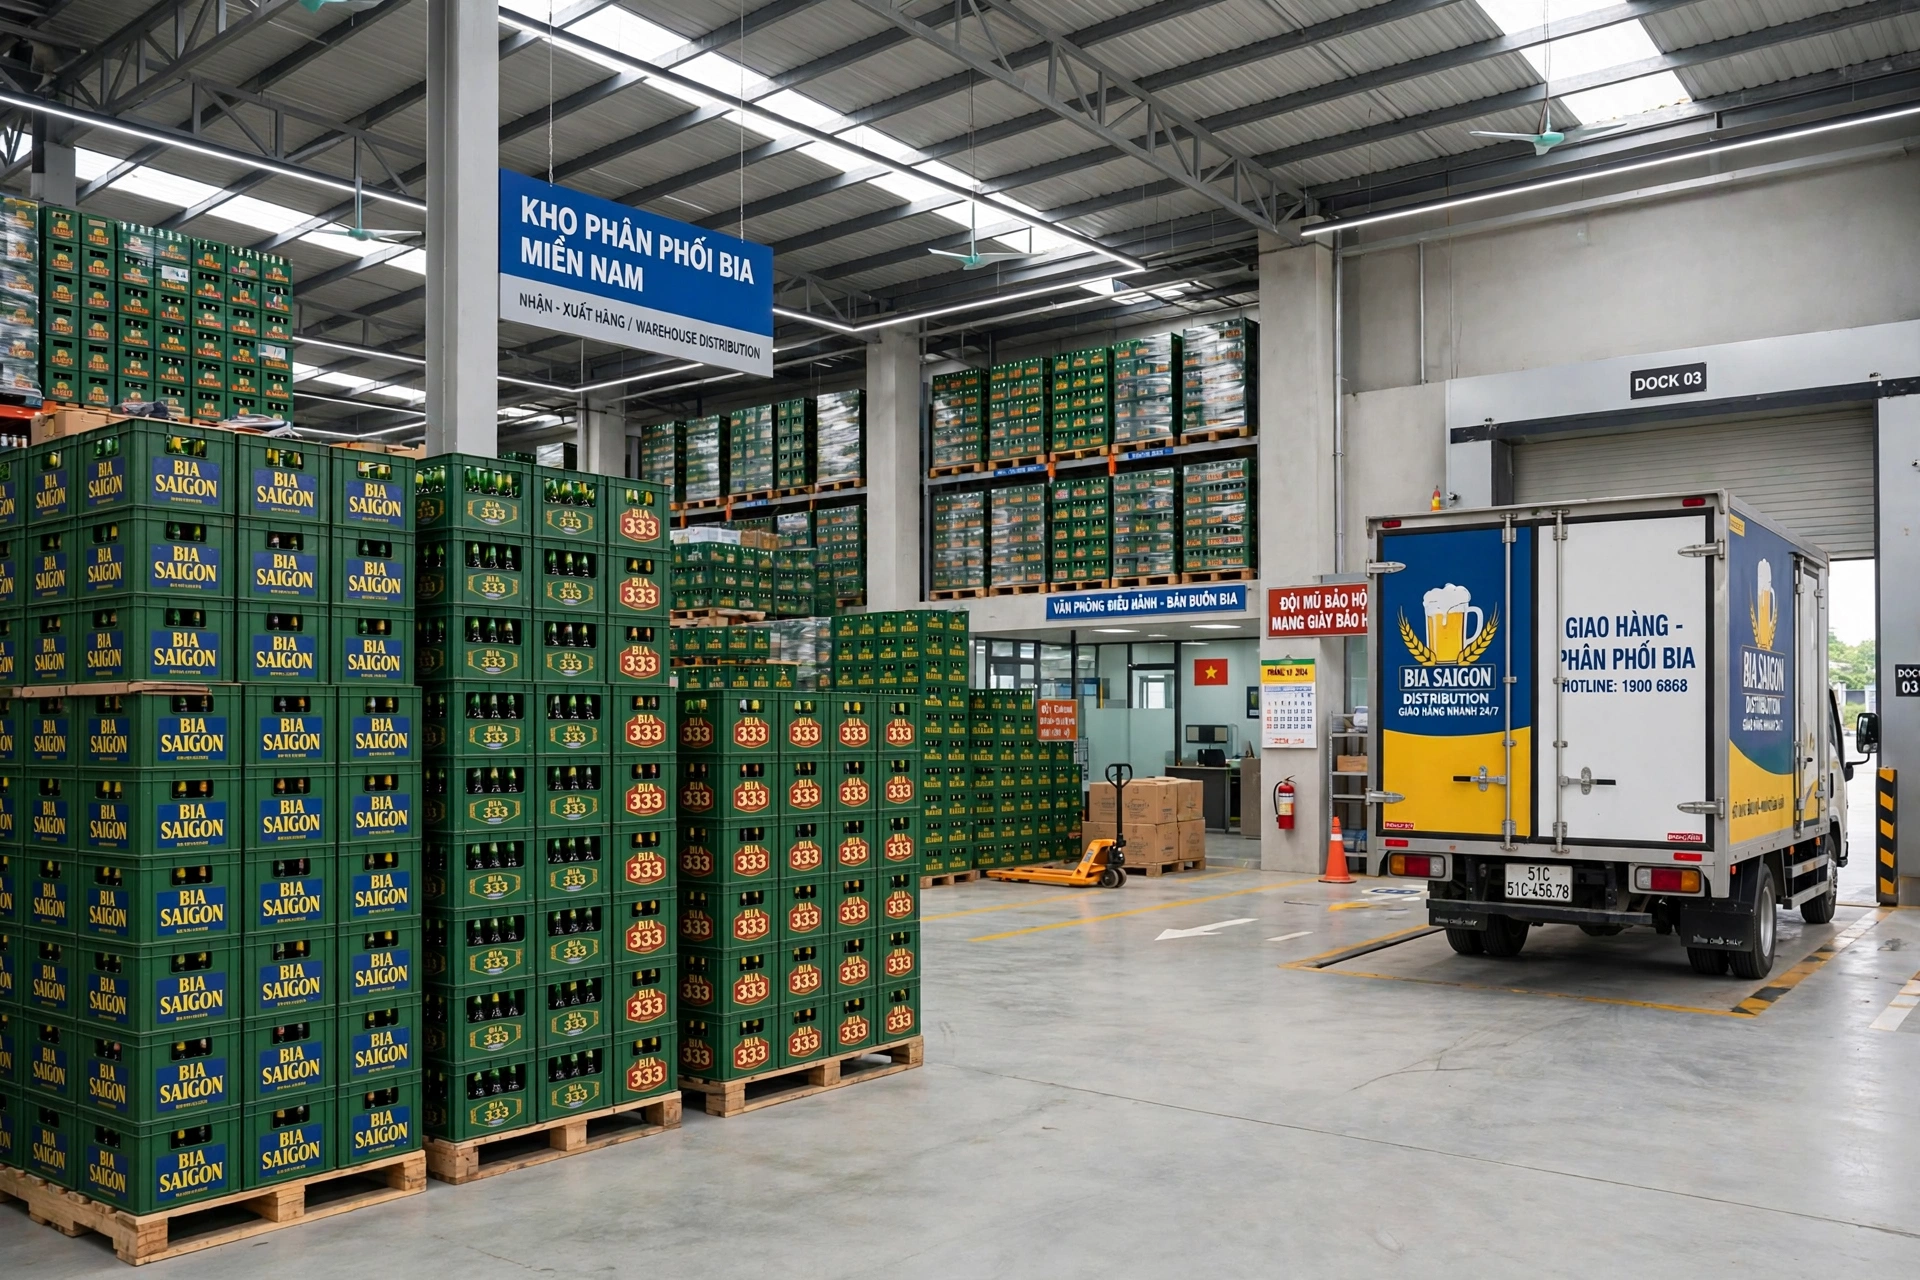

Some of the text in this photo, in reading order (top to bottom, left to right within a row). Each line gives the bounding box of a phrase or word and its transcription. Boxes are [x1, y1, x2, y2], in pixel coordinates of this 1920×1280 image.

[521, 195, 755, 285] KHO PHÂN PHỐI BIA
[521, 235, 643, 292] MIỀN NAM
[519, 293, 553, 315] NHẬN
[563, 301, 593, 321] XUẤT
[627, 316, 633, 331] /
[636, 320, 697, 345] WAREHOUSE
[700, 334, 761, 360] DISTRIBUTION
[1635, 371, 1702, 391] DOCK 03
[98, 458, 113, 477] BIA
[174, 460, 200, 477] BIA
[88, 475, 123, 498] SAIGON
[155, 474, 217, 497] SAIGON
[274, 472, 297, 488] BIA
[256, 485, 314, 507] SAIGON
[365, 483, 386, 498] BIA
[349, 496, 401, 516] SAIGON
[632, 508, 649, 519] BIA
[624, 518, 656, 535] 333
[174, 546, 199, 562] BIA
[274, 554, 297, 569] BIA
[154, 561, 216, 581] SAIGON
[365, 562, 386, 576] BIA
[256, 568, 313, 588] SAIGON
[348, 575, 401, 593] SAIGON
[632, 578, 649, 588] BIA
[624, 588, 656, 604] 333
[1220, 592, 1238, 605] BIA
[1272, 615, 1304, 631] MANG
[1565, 616, 1609, 639] GIAO
[1616, 610, 1669, 637] HÀNG
[173, 632, 198, 648] BIA
[274, 636, 296, 651] BIA
[364, 640, 385, 654] BIA
[154, 647, 216, 667] SAIGON
[632, 646, 649, 655] BIA
[1612, 640, 1656, 670] PHỐI
[1663, 646, 1696, 669] BIA
[256, 651, 313, 669] SAIGON
[347, 654, 400, 671] SAIGON
[624, 655, 656, 672] 333
[1404, 667, 1491, 687] BIA SAIGON
[1743, 651, 1784, 691] BIA SAIGON
[1897, 668, 1920, 678] DOC
[1562, 679, 1688, 693] HOTLINE: 1900 6868
[1902, 680, 1919, 694] 03
[1403, 692, 1489, 705] DISTRIBUTION
[1447, 706, 1477, 716] NHANH
[1479, 706, 1499, 716] 24/7
[100, 719, 117, 734] BIA
[180, 718, 206, 733] BIA
[281, 718, 304, 732] BIA
[372, 718, 392, 731] BIA
[638, 715, 654, 724] BIA
[745, 717, 760, 726] BIA
[848, 718, 860, 726] BIA
[894, 719, 906, 727] BIA
[483, 731, 508, 743] 333
[630, 724, 662, 741] 333
[737, 727, 766, 741] 333
[842, 728, 866, 741] 333
[889, 728, 911, 740] 333
[90, 735, 128, 754] SAIGON
[161, 734, 224, 753] SAIGON
[263, 733, 320, 751] SAIGON
[355, 733, 408, 749] SAIGON
[638, 784, 654, 793] BIA
[745, 782, 760, 790] BIA
[372, 796, 392, 810] BIA
[630, 793, 662, 809] 333
[737, 791, 766, 805] 333
[180, 804, 205, 819] BIA
[281, 800, 304, 814] BIA
[263, 814, 320, 833] SAIGON
[355, 810, 408, 828] SAIGON
[160, 819, 223, 840] SAIGON
[638, 852, 654, 862] BIA
[745, 845, 760, 854] BIA
[630, 862, 662, 878] 333
[737, 855, 766, 870] 333
[372, 874, 392, 889] BIA
[1527, 866, 1550, 881] 51C
[180, 889, 206, 906] BIA
[281, 882, 304, 897] BIA
[355, 888, 408, 907] SAIGON
[1507, 881, 1569, 899] 51C-456.78
[262, 895, 320, 917] SAIGON
[745, 909, 760, 918] BIA
[160, 904, 223, 927] SAIGON
[638, 920, 655, 930] BIA
[737, 918, 766, 935] 333
[630, 930, 662, 948] 333
[371, 952, 392, 967] BIA
[280, 964, 304, 980] BIA
[355, 965, 408, 987] SAIGON
[745, 973, 760, 983] BIA
[180, 976, 205, 993] BIA
[262, 977, 320, 1001] SAIGON
[737, 982, 766, 999] 333
[639, 988, 655, 999] BIA
[160, 990, 223, 1015] SAIGON
[631, 998, 662, 1017] 333
[371, 1032, 392, 1047] BIA
[745, 1037, 760, 1047] BIA
[280, 1046, 304, 1063] BIA
[355, 1044, 408, 1068] SAIGON
[639, 1057, 655, 1068] BIA
[737, 1046, 766, 1064] 333
[180, 1062, 205, 1080] BIA
[262, 1059, 320, 1085] SAIGON
[631, 1066, 663, 1087] 333
[160, 1076, 223, 1104] SAIGON
[371, 1110, 393, 1127] BIA
[280, 1129, 304, 1147] BIA
[355, 1123, 408, 1149] SAIGON
[179, 1150, 205, 1169] BIA
[262, 1142, 320, 1170] SAIGON
[159, 1163, 223, 1193] SAIGON
